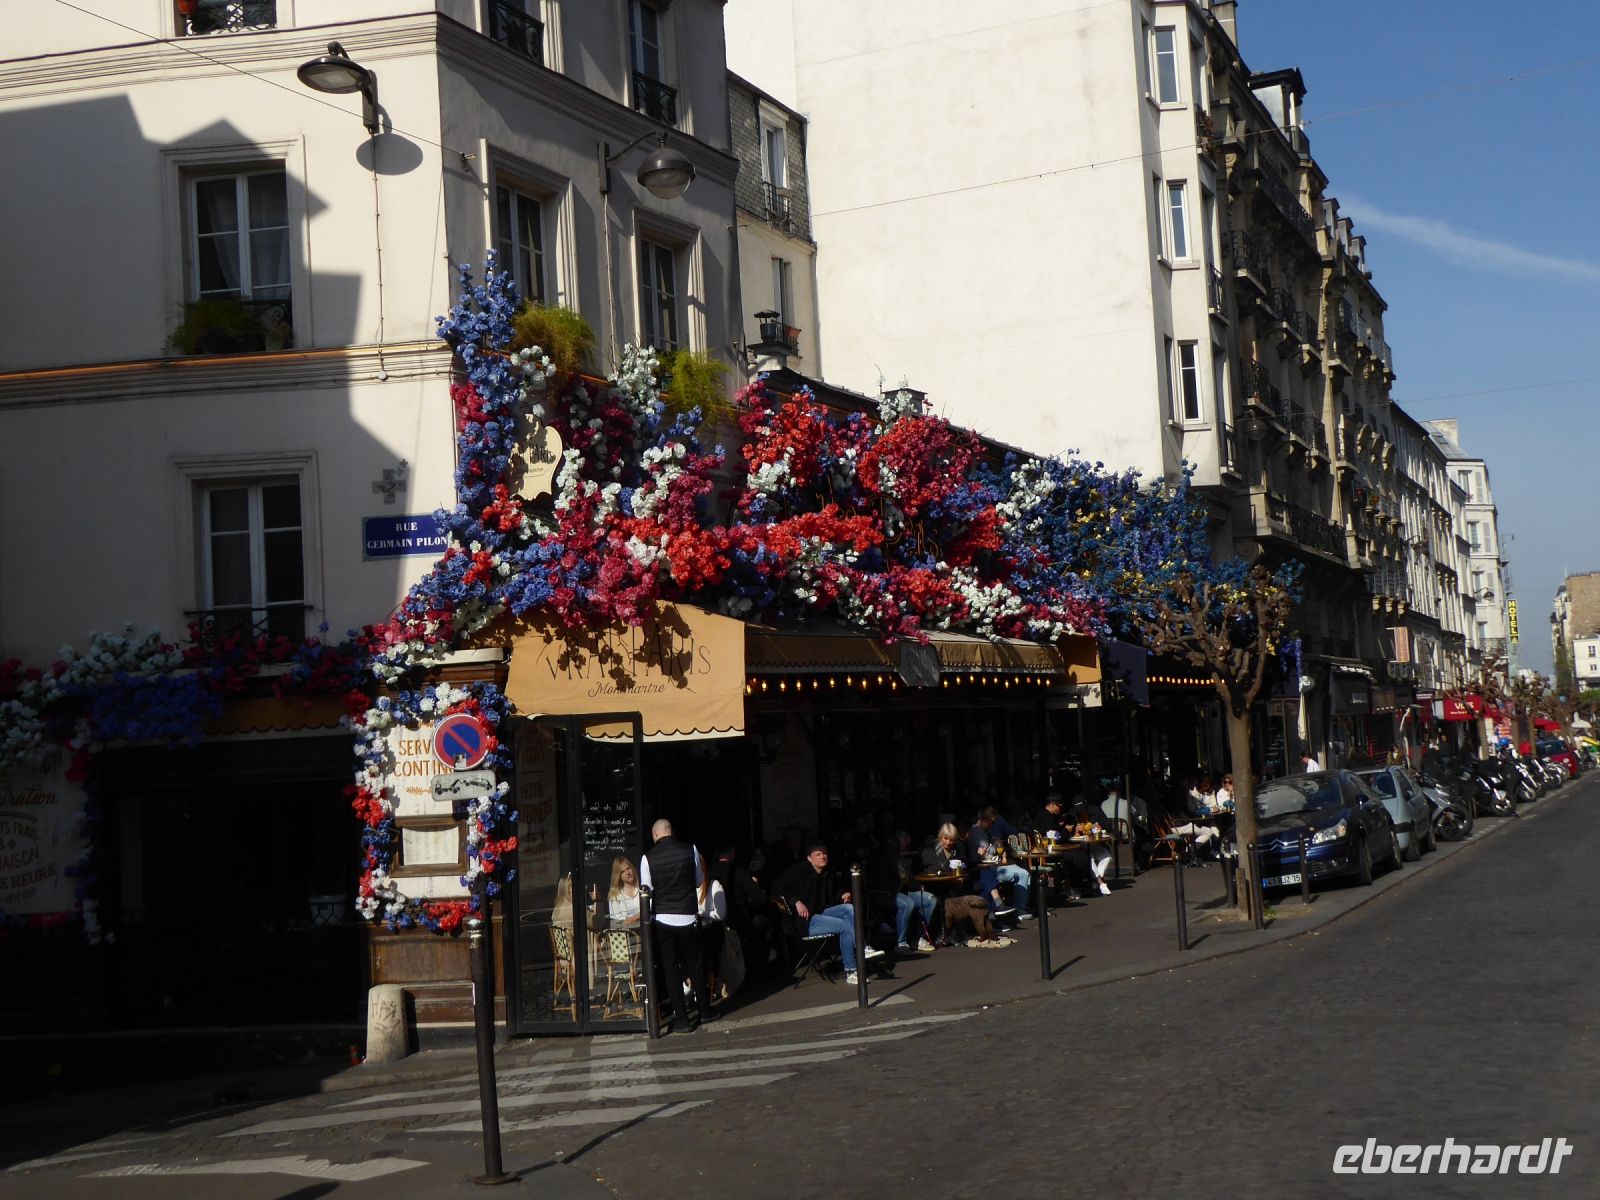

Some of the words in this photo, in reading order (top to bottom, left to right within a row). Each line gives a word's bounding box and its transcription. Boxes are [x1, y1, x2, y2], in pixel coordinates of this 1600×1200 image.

[395, 522, 418, 531] RUE
[367, 538, 413, 549] GERMAIN
[416, 536, 447, 547] PILON
[1508, 600, 1518, 634] HOTEL
[587, 681, 665, 698] Monmartre
[398, 739, 434, 756] SERV
[11, 862, 56, 888] HEURE
